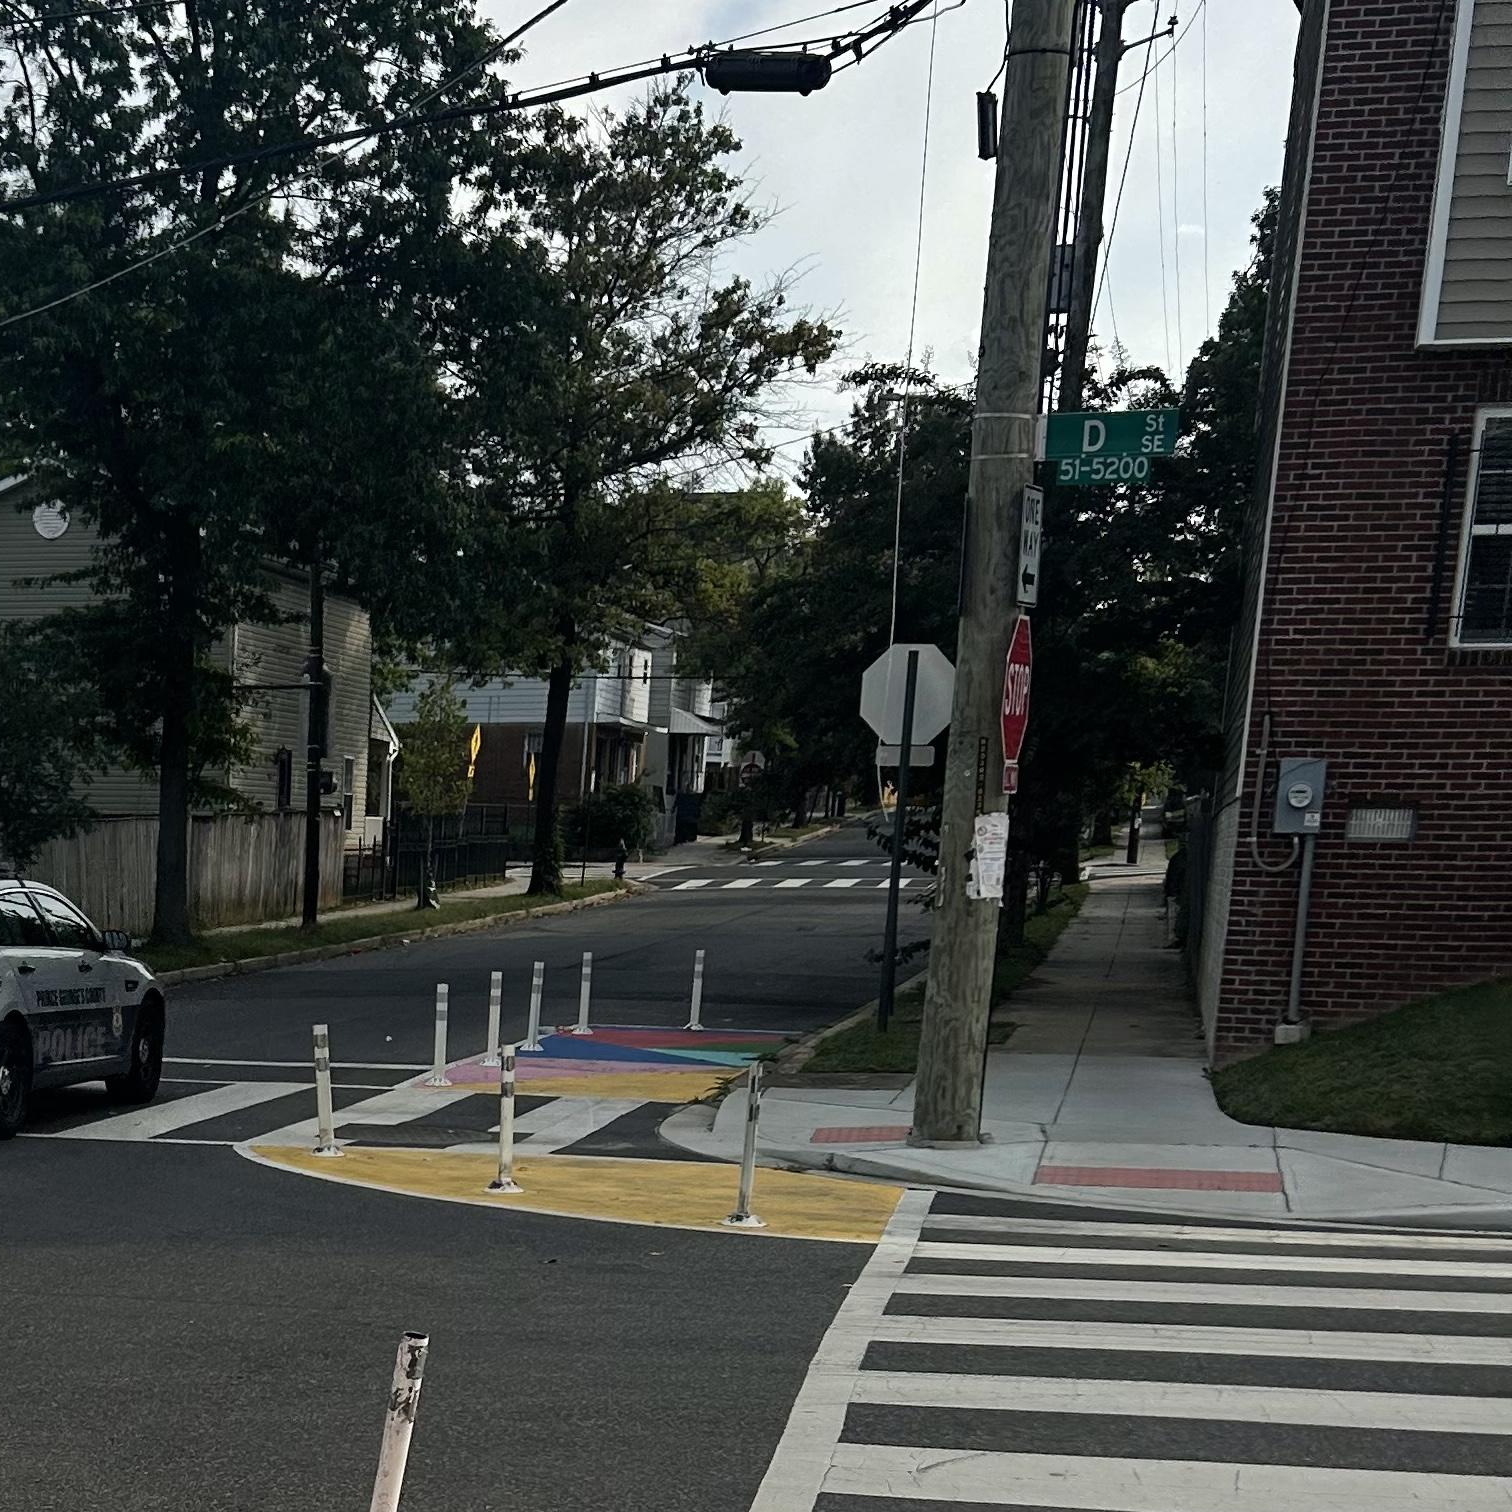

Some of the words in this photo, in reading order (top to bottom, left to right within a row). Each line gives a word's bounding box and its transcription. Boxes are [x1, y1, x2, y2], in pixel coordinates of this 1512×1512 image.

[1082, 419, 1106, 452] D
[1145, 414, 1164, 432] St
[1141, 434, 1164, 452] SE
[1059, 456, 1148, 480] 51-5200
[1025, 494, 1040, 525] ONE
[1023, 527, 1039, 557] WAY
[1005, 663, 1030, 716] STOP
[35, 1026, 106, 1061] POLICE
